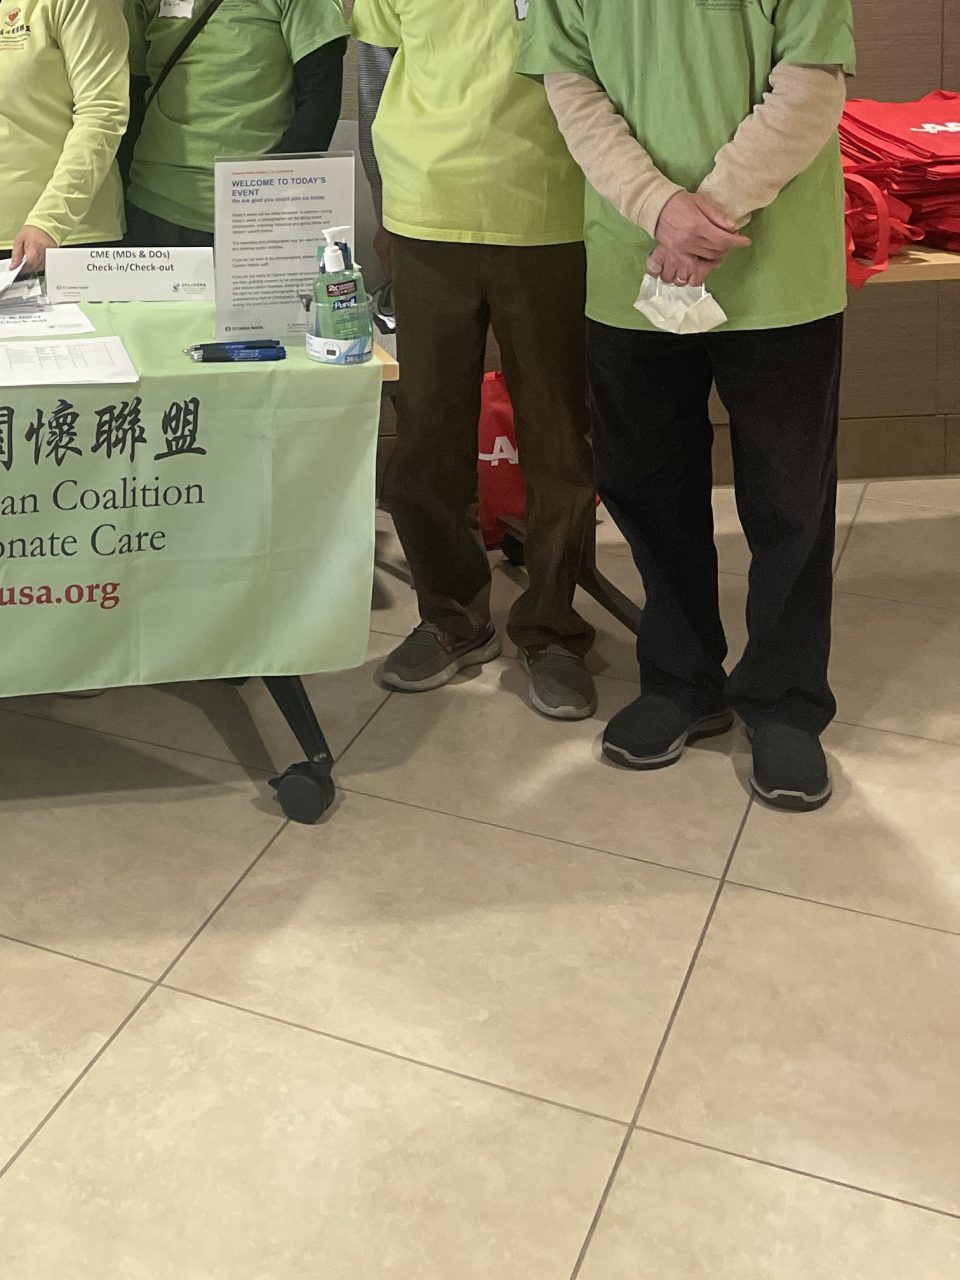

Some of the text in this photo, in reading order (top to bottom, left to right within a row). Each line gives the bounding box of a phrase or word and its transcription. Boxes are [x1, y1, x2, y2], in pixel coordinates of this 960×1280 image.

[232, 176, 327, 188] WELCOME TO TODAY'S
[232, 188, 260, 197] EVENT
[90, 250, 171, 260] CME (MDs & DOs)
[86, 263, 175, 273] Check-in/Check-out
[52, 476, 206, 512] Coalition
[90, 523, 168, 557] Care
